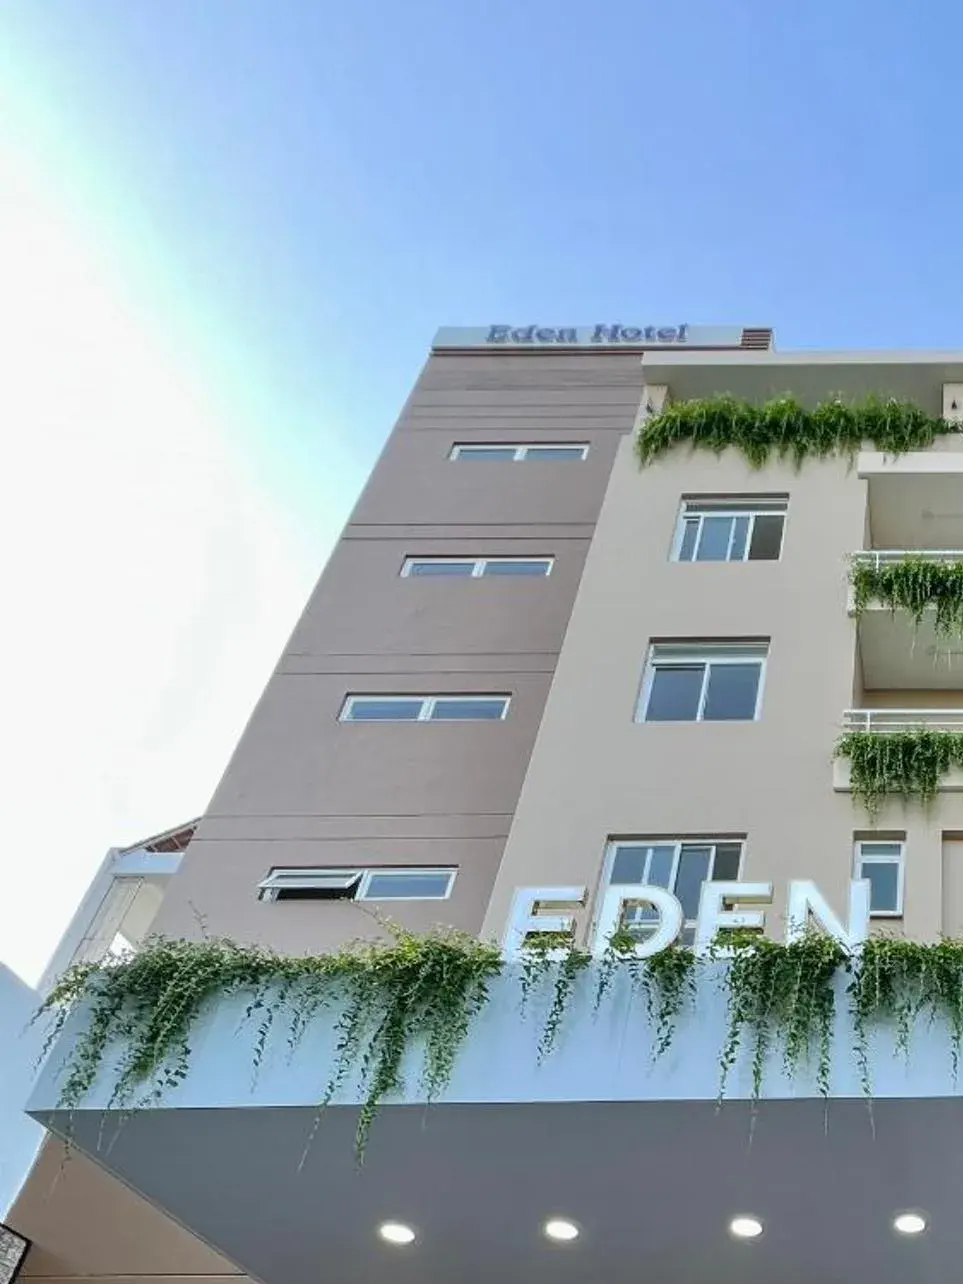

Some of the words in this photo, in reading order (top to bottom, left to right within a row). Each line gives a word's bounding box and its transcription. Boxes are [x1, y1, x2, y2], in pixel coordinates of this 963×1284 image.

[486, 324, 577, 343] Eden
[592, 323, 689, 343] Hotel
[504, 880, 872, 961] EDEN
